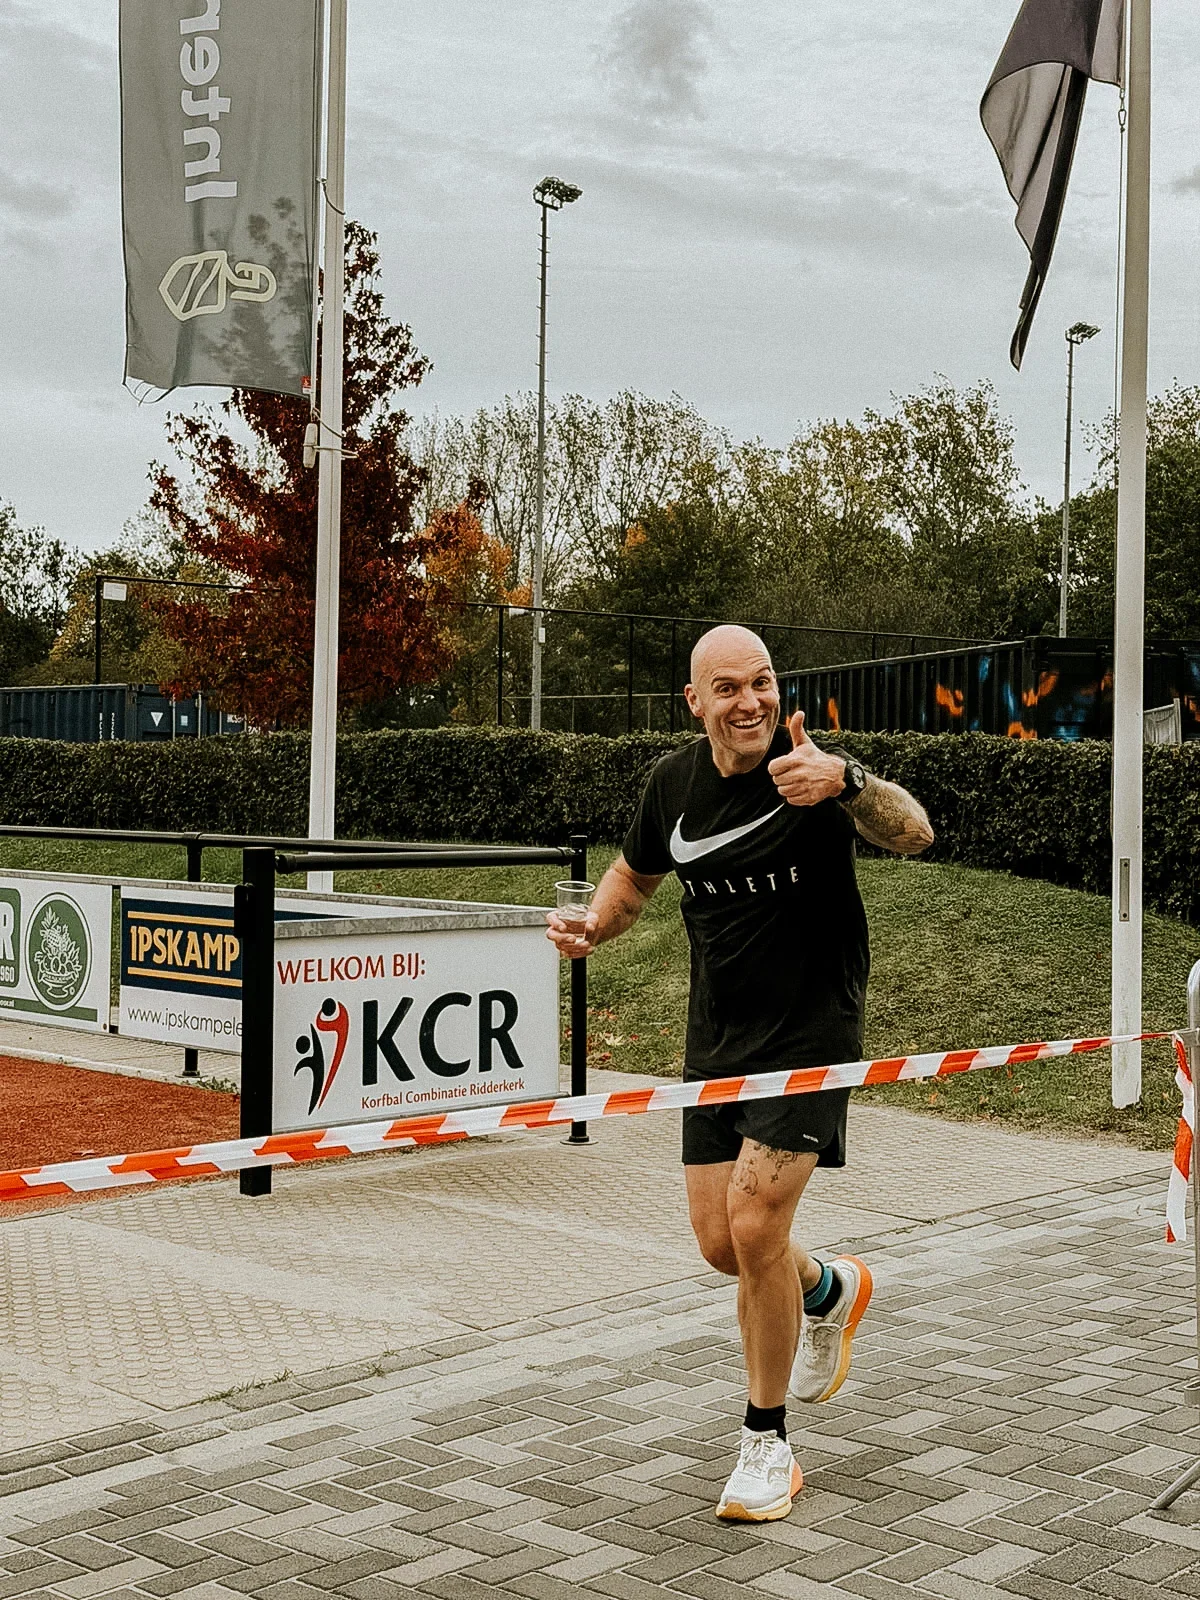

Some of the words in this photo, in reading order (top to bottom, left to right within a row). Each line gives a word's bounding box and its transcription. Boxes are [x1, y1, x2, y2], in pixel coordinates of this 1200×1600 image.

[130, 925, 240, 972] IPSKAMP
[277, 954, 385, 985] WELKOM
[392, 952, 426, 980] BIJ:
[362, 989, 524, 1086] KCR
[361, 1091, 403, 1109] Korfbal
[405, 1084, 467, 1104] Combinatie
[469, 1077, 525, 1096] Ridderkerk
